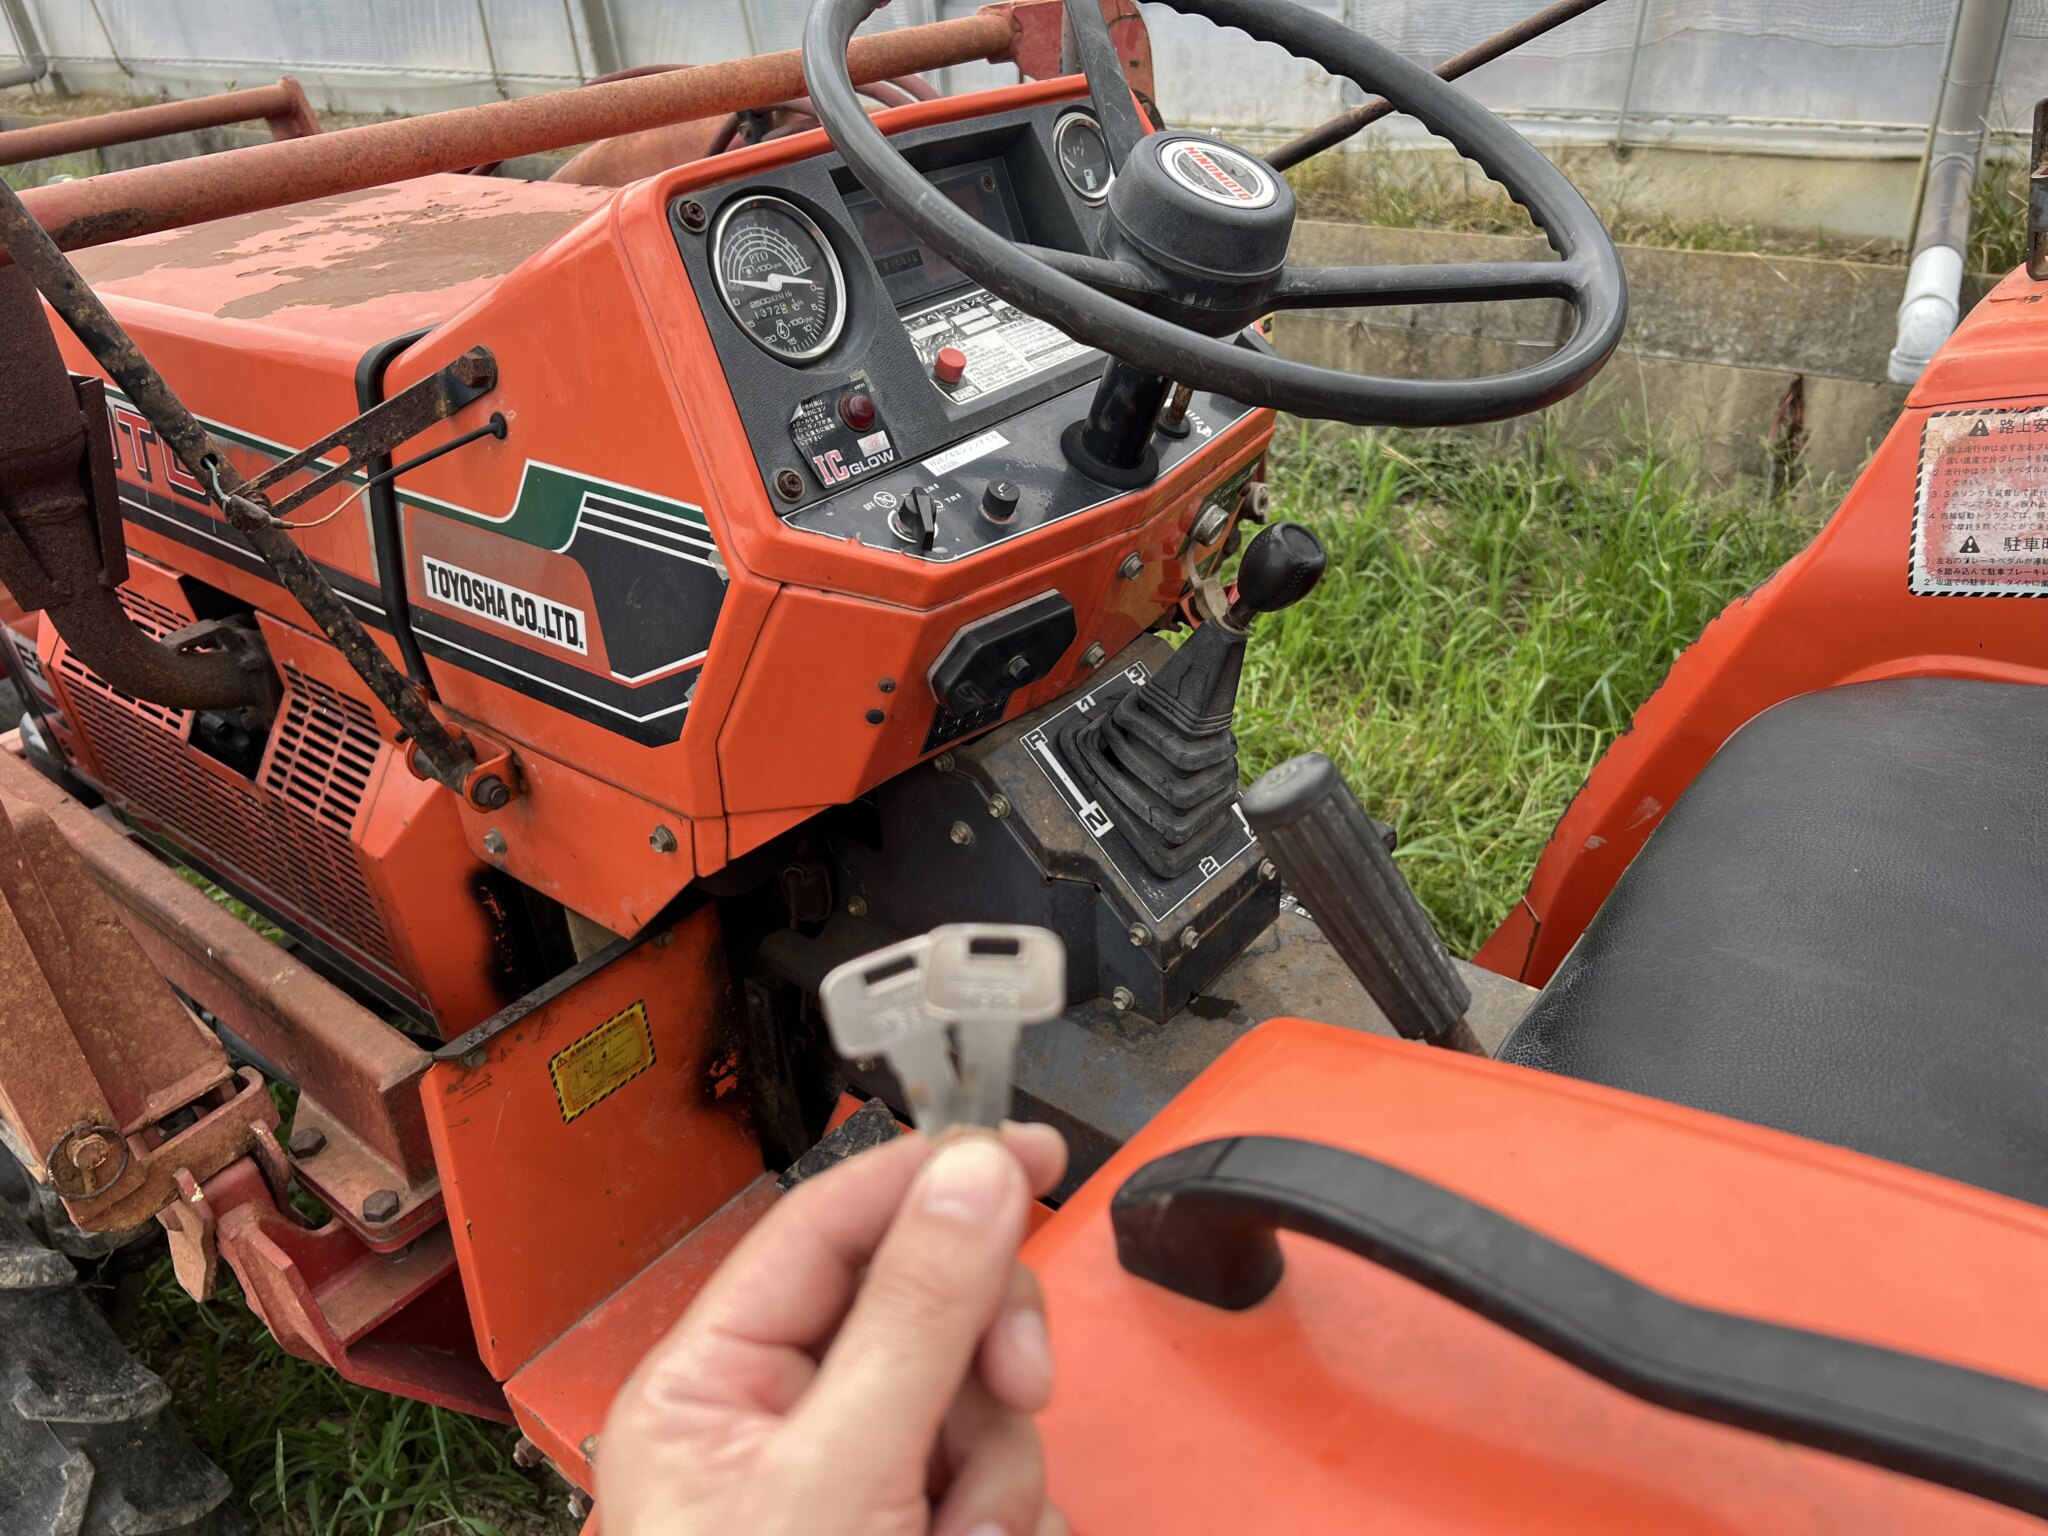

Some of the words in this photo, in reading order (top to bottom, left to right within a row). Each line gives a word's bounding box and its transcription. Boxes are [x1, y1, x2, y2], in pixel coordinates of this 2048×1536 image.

[1184, 146, 1255, 201] HINOMOTO
[812, 449, 850, 485] IC
[849, 449, 894, 475] GLOW
[426, 562, 509, 622] TOYOSHA
[1126, 666, 1143, 681] 3
[1025, 730, 1046, 748] R
[1084, 807, 1108, 832] N
[1200, 857, 1218, 877] 2
